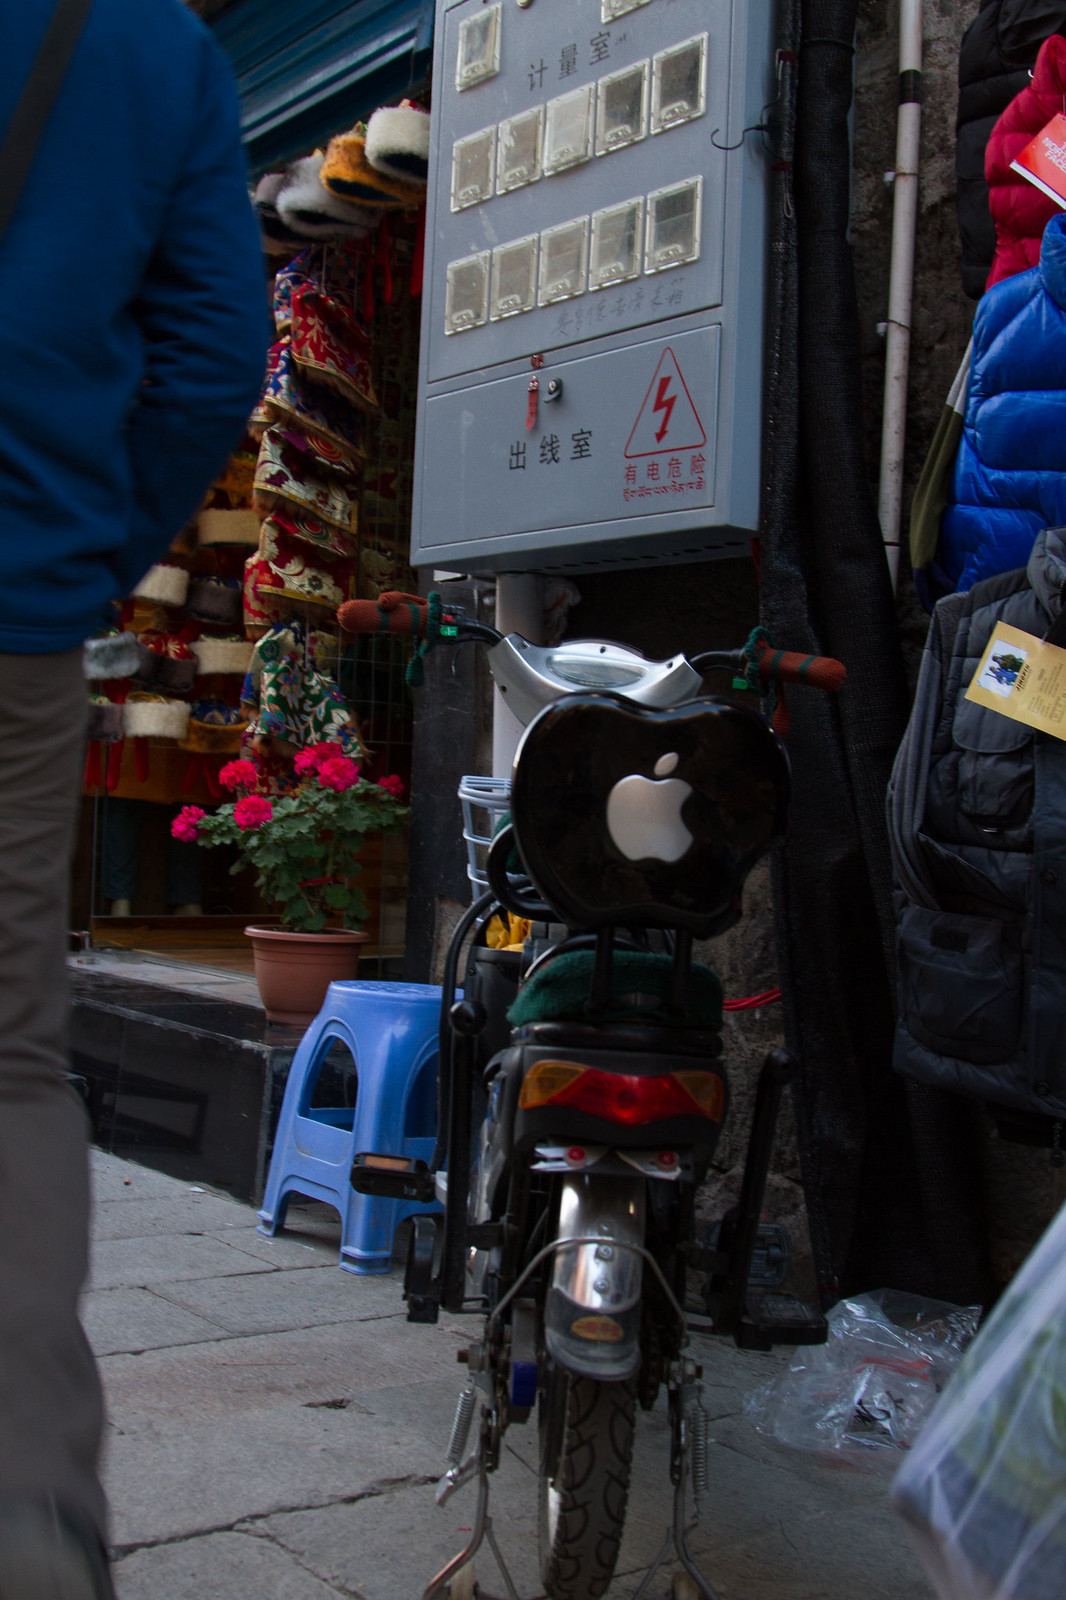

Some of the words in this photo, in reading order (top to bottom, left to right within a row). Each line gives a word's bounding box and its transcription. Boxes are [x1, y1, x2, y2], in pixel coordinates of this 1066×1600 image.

[528, 31, 610, 91] 计量室
[509, 428, 592, 470] 出线室
[624, 453, 705, 485] 有电危险
